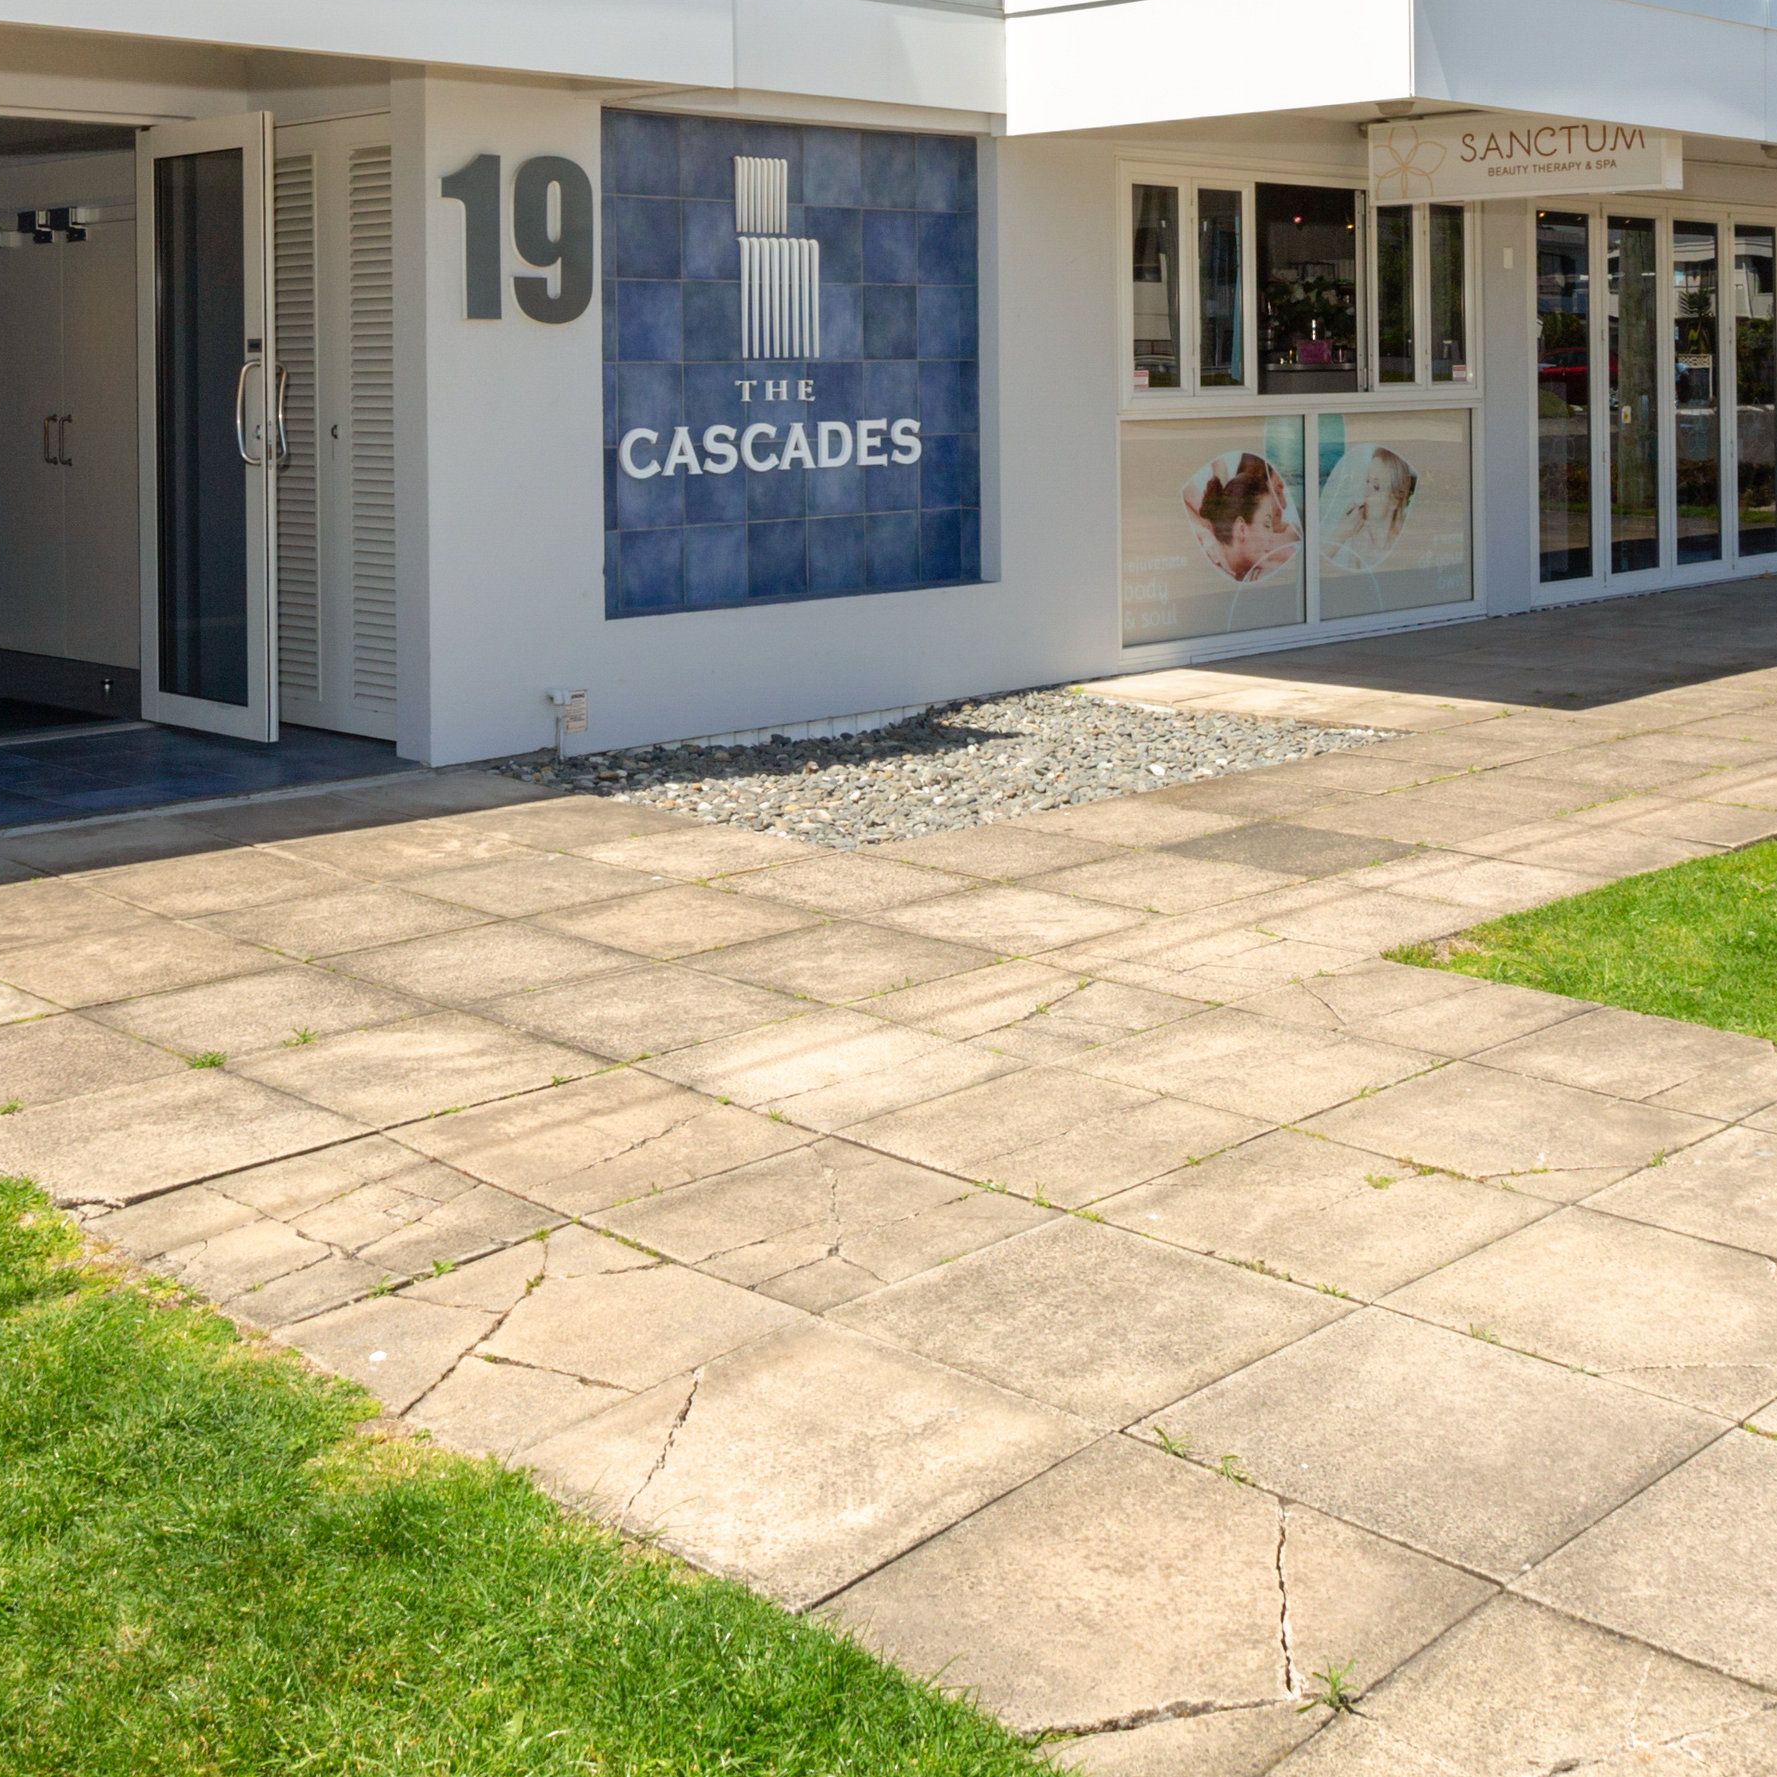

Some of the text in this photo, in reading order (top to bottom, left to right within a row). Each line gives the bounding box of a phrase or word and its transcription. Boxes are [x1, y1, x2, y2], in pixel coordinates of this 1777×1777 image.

[1460, 124, 1646, 163] SANCTUM
[1487, 158, 1618, 177] BEAUTY THERAPY & SPA
[438, 153, 594, 325] 19
[734, 379, 816, 402] THE
[619, 417, 923, 480] CASCADES
[1123, 576, 1169, 605] body
[1123, 603, 1178, 630] & soul
